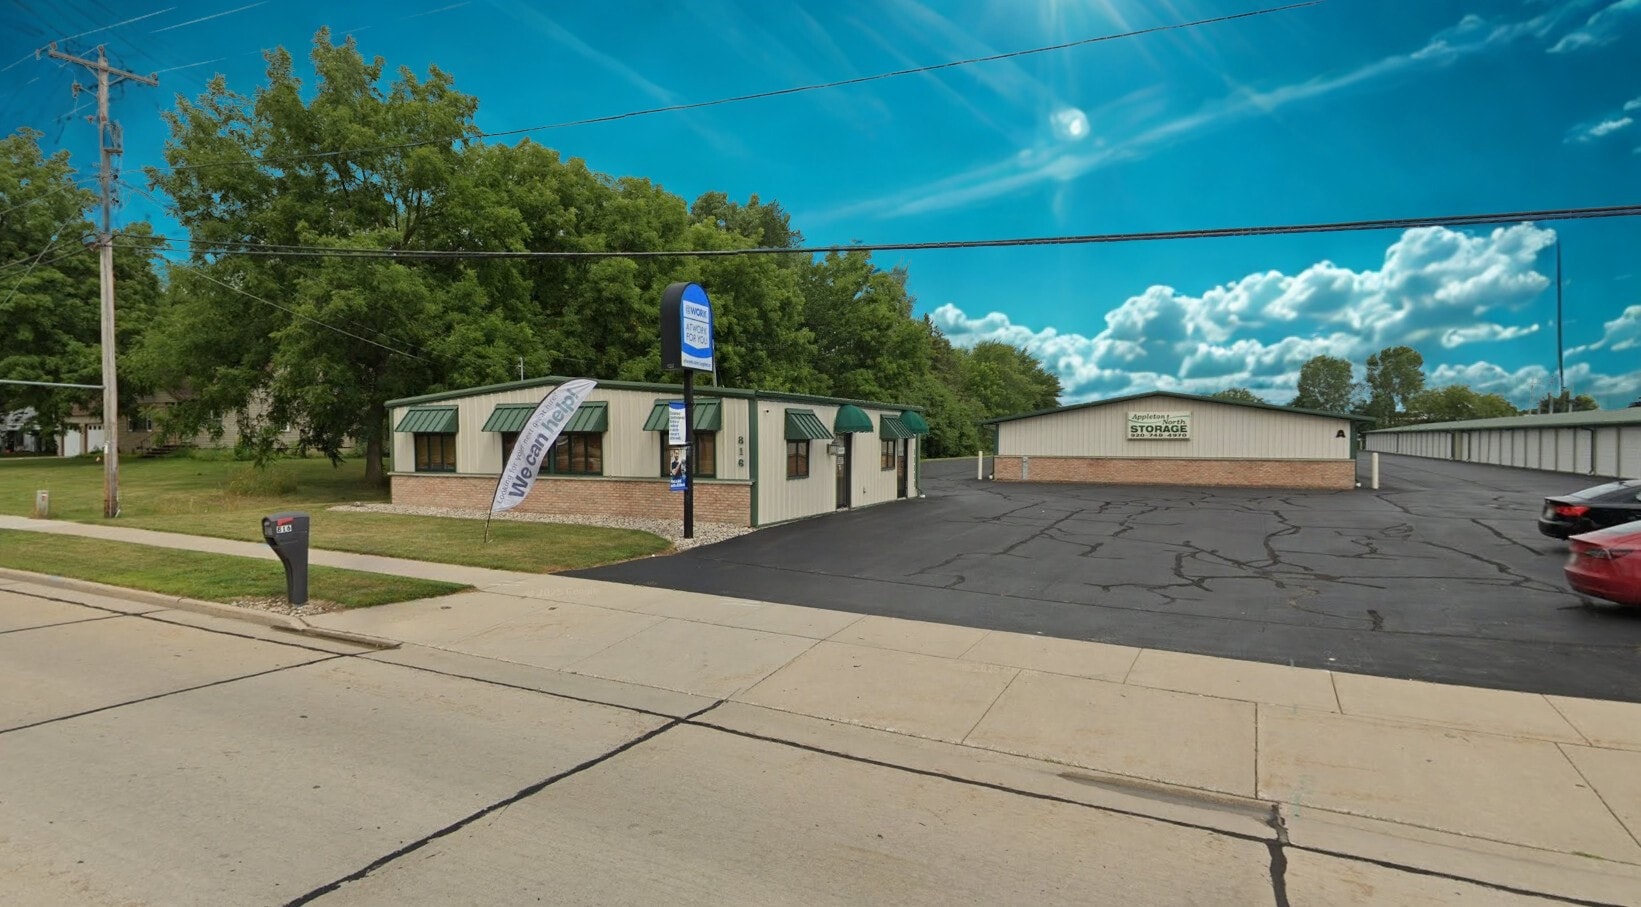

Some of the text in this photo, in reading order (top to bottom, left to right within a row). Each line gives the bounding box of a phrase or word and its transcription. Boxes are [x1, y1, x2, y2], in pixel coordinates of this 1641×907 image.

[686, 334, 707, 345] FOR YOU
[1130, 425, 1188, 433] STORAGE
[1336, 430, 1345, 438] A
[509, 388, 579, 497] We can help!
[509, 463, 518, 474] for
[515, 444, 524, 461] your
[523, 428, 534, 444] next
